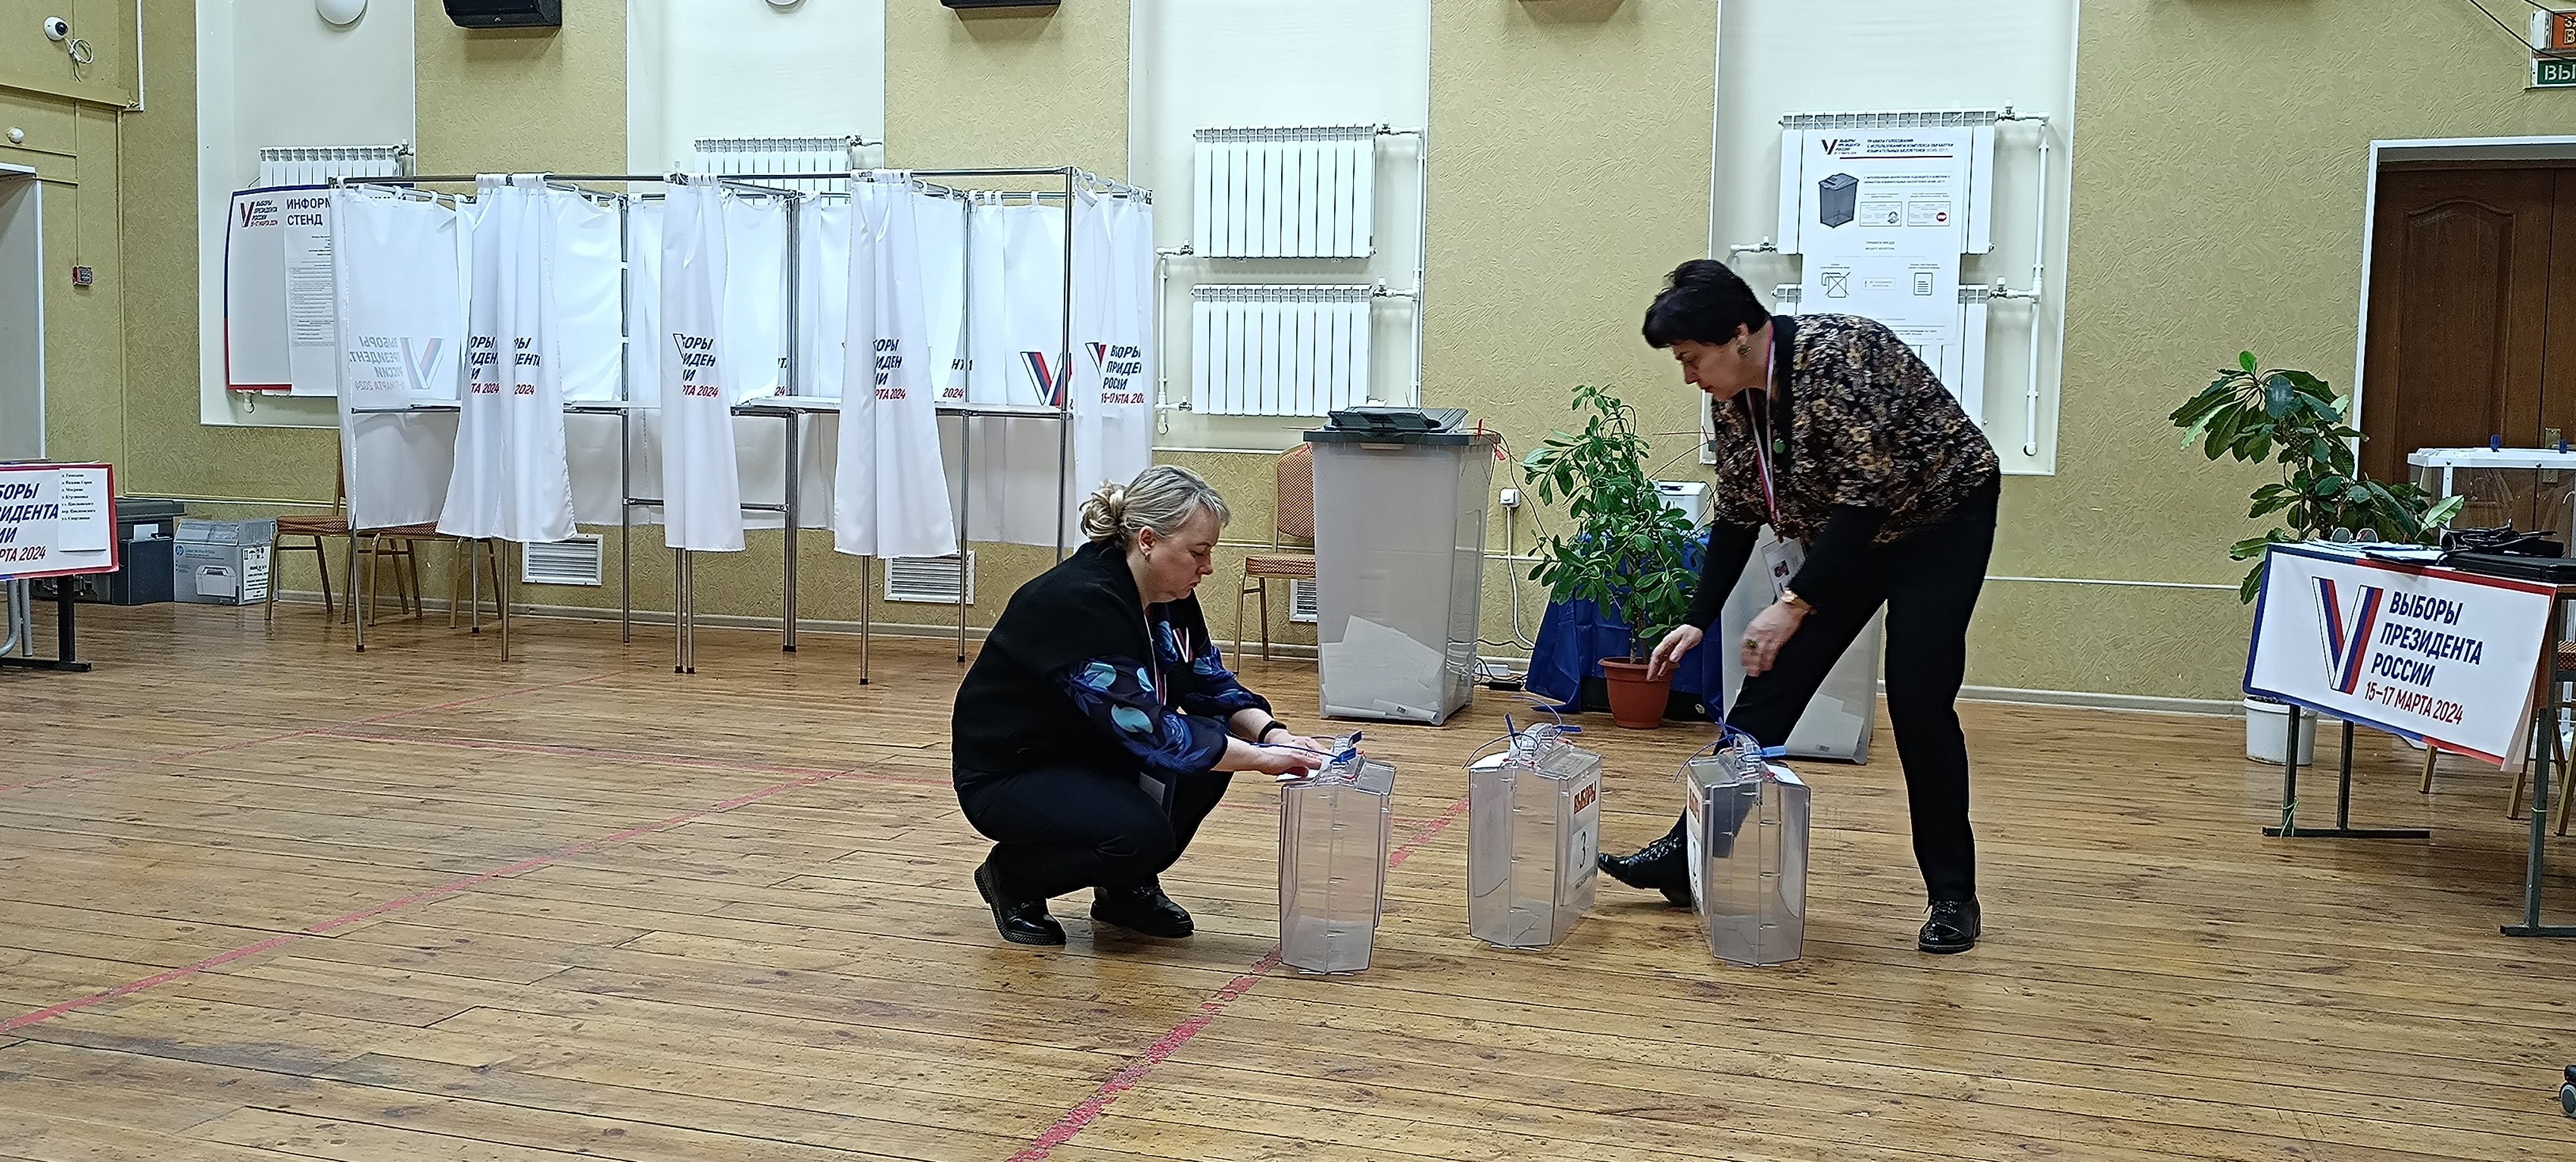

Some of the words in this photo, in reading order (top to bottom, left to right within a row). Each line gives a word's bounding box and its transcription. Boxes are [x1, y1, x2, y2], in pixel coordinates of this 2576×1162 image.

[287, 213, 323, 226] СТЕНД
[696, 385, 719, 397] 2024
[943, 387, 965, 398] 2024
[0, 503, 59, 524] ИДЕНТА
[18, 546, 46, 561] 2024
[2389, 591, 2464, 626] ВЫБОРЫ
[2380, 622, 2483, 665] ПРЕЗИДЕНТА
[2371, 652, 2436, 688] РОССИИ
[2394, 689, 2433, 717] МАРТА
[2432, 698, 2464, 726] 2024
[1579, 830, 1587, 870] 3
